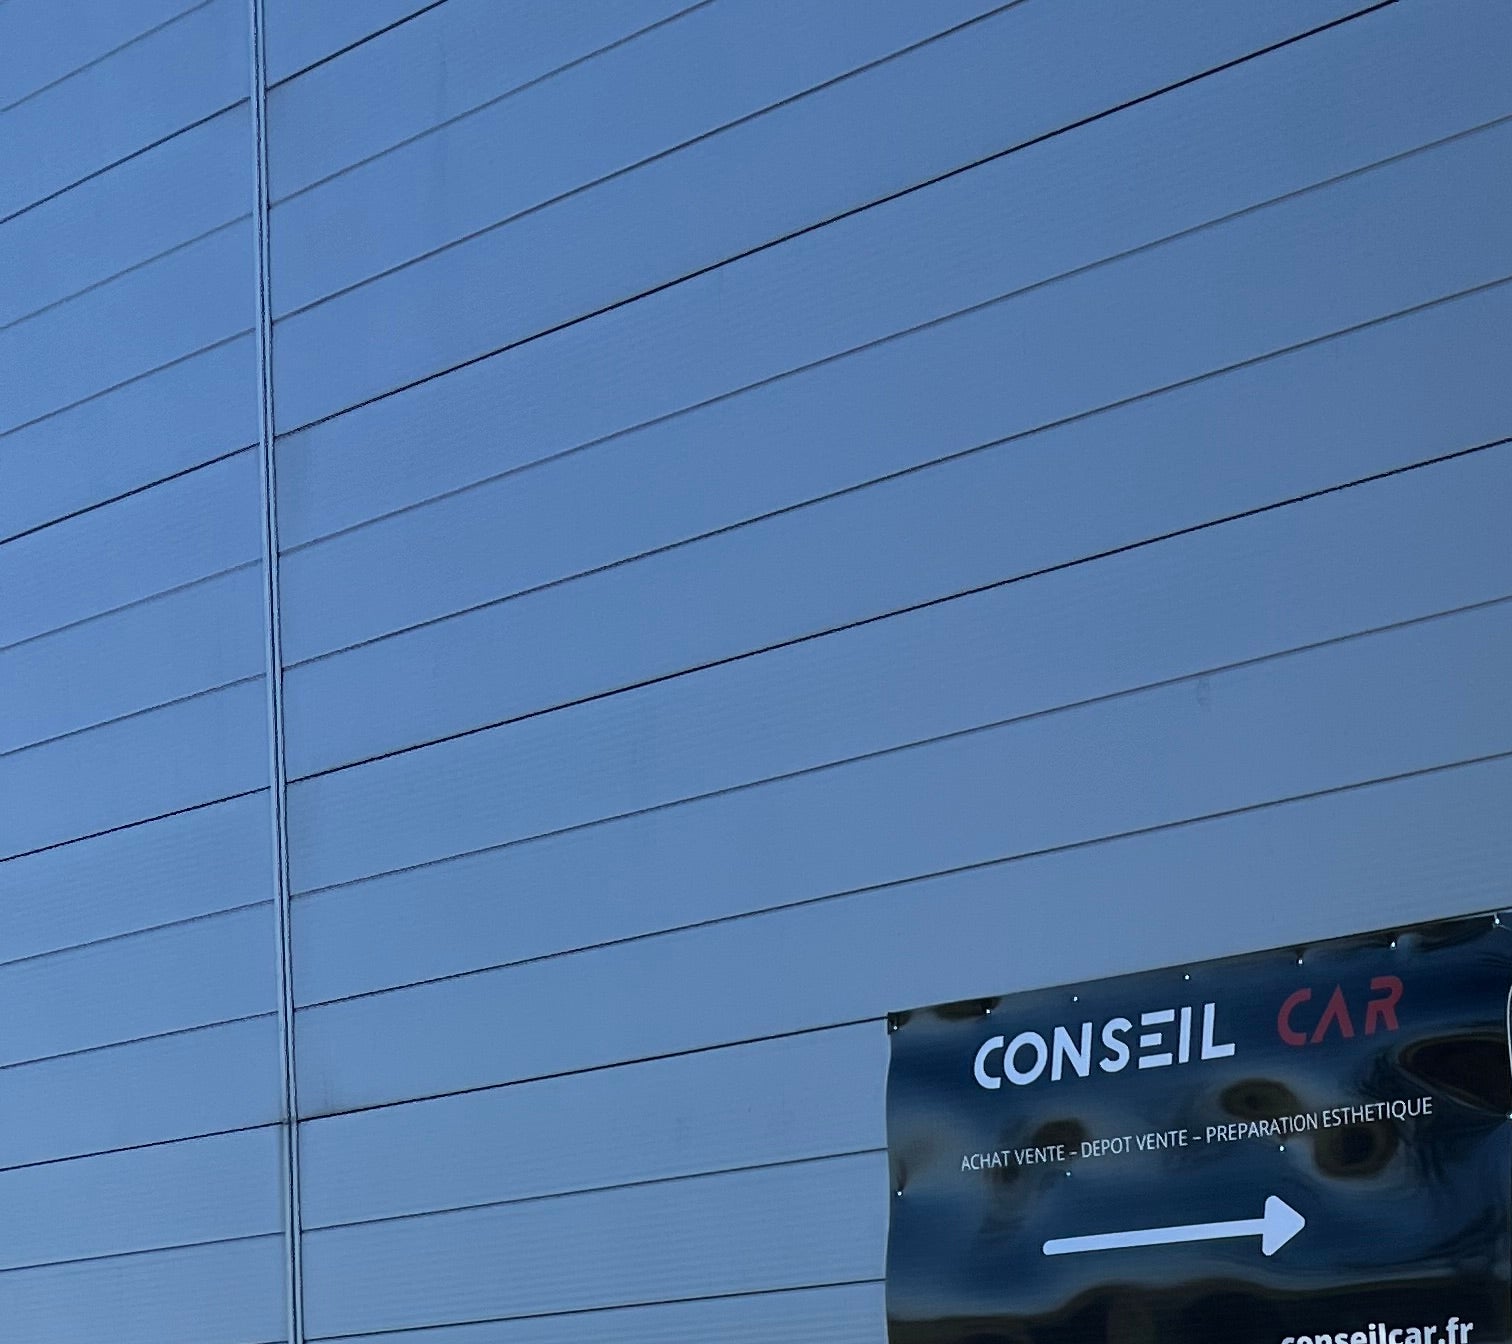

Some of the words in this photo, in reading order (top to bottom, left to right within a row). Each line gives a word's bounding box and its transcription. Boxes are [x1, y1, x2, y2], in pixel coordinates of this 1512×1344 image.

[974, 1002, 1236, 1089] CONSEIL
[1277, 974, 1404, 1047] CAR
[961, 1150, 1011, 1172] ACHAT
[1014, 1144, 1065, 1165] VENTE
[1081, 1135, 1133, 1158] DEPOT
[1136, 1129, 1188, 1151] VENTE
[1206, 1113, 1318, 1144] PREPARATION
[1322, 1096, 1433, 1128] ESTHETIQUE
